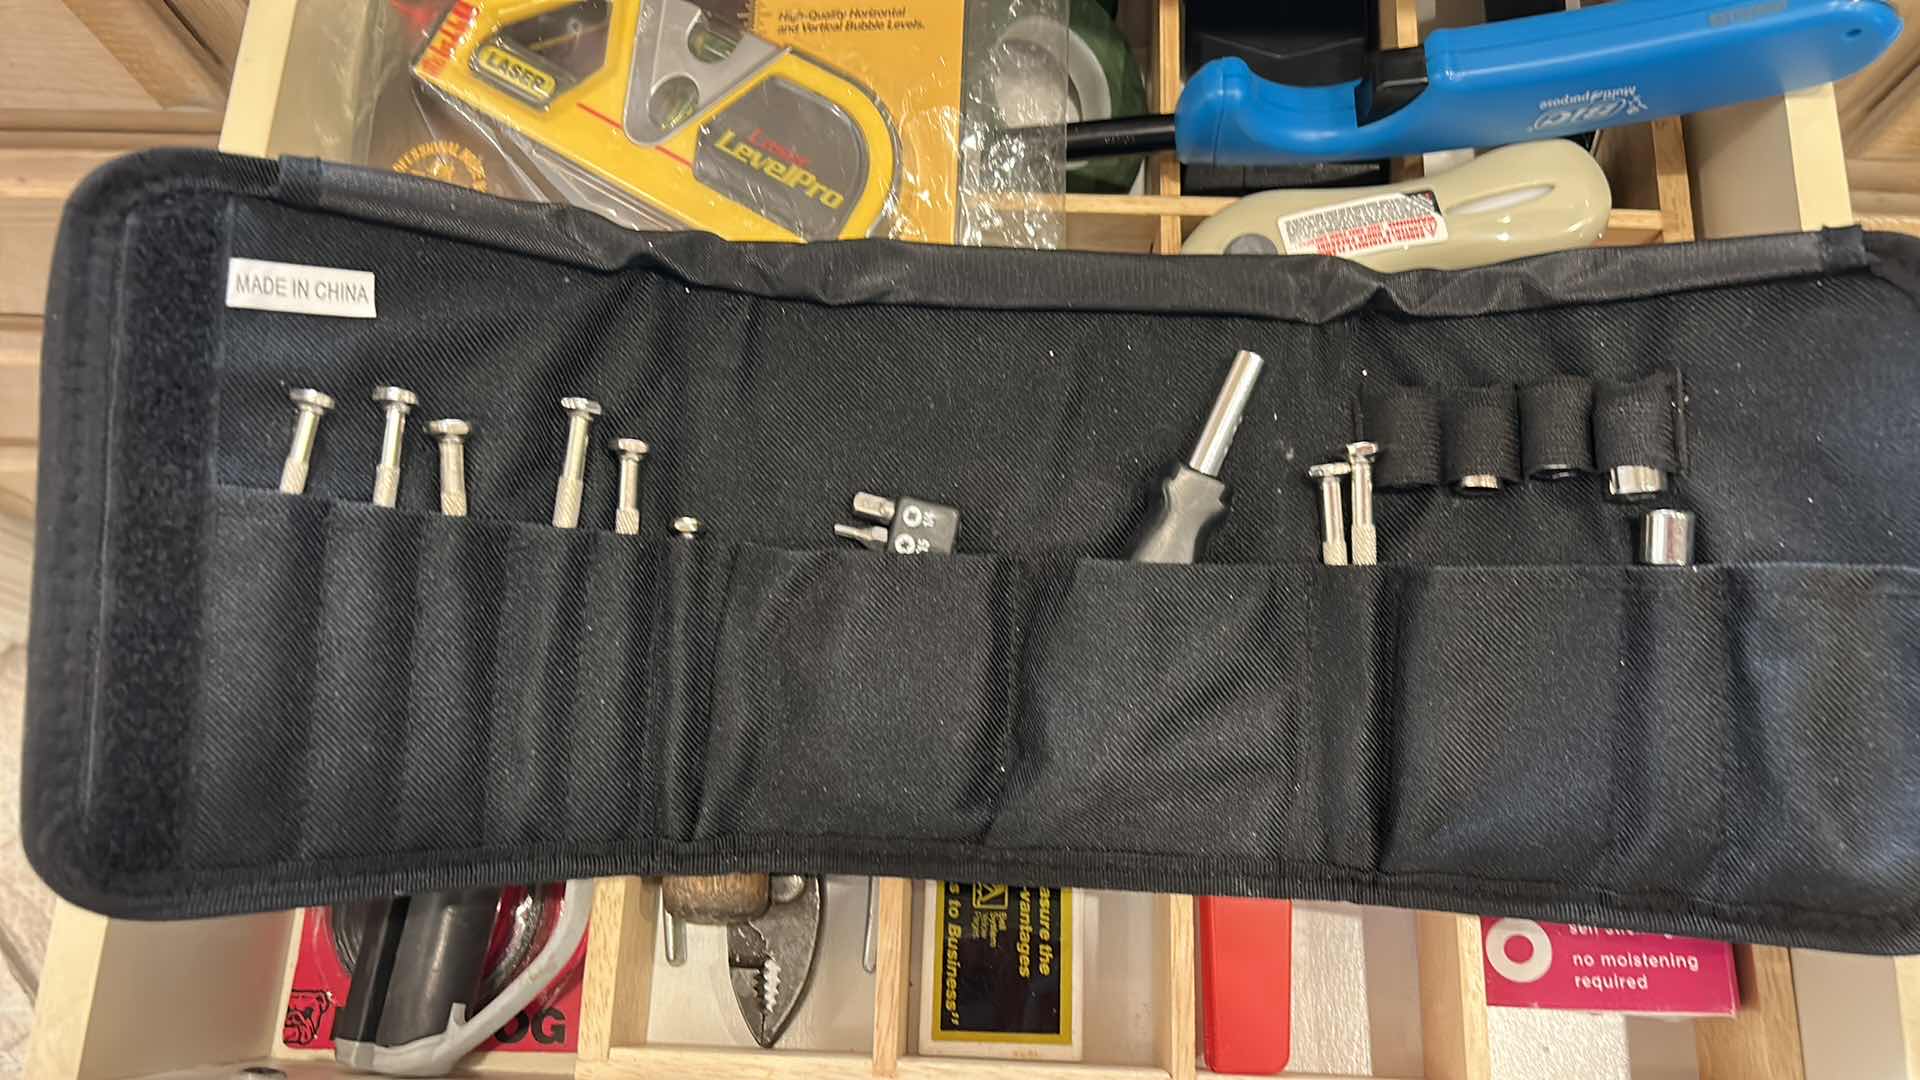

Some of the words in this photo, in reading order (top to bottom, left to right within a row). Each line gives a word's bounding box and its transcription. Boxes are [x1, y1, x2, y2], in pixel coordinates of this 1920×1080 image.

[849, 7, 906, 19] Horizontal
[778, 22, 799, 33] and
[801, 21, 842, 33] Vertical
[845, 20, 884, 32] Bubble
[485, 50, 547, 94] LASER
[714, 128, 845, 209] LevelPro
[235, 273, 288, 298] MADE
[292, 278, 310, 299] IN
[315, 280, 370, 305] CHINA
[948, 899, 961, 918] to
[1016, 886, 1033, 978] vantages
[1039, 944, 1054, 976] the
[1572, 953, 1595, 967] no
[1600, 952, 1699, 973] moistening
[1574, 974, 1648, 992] required
